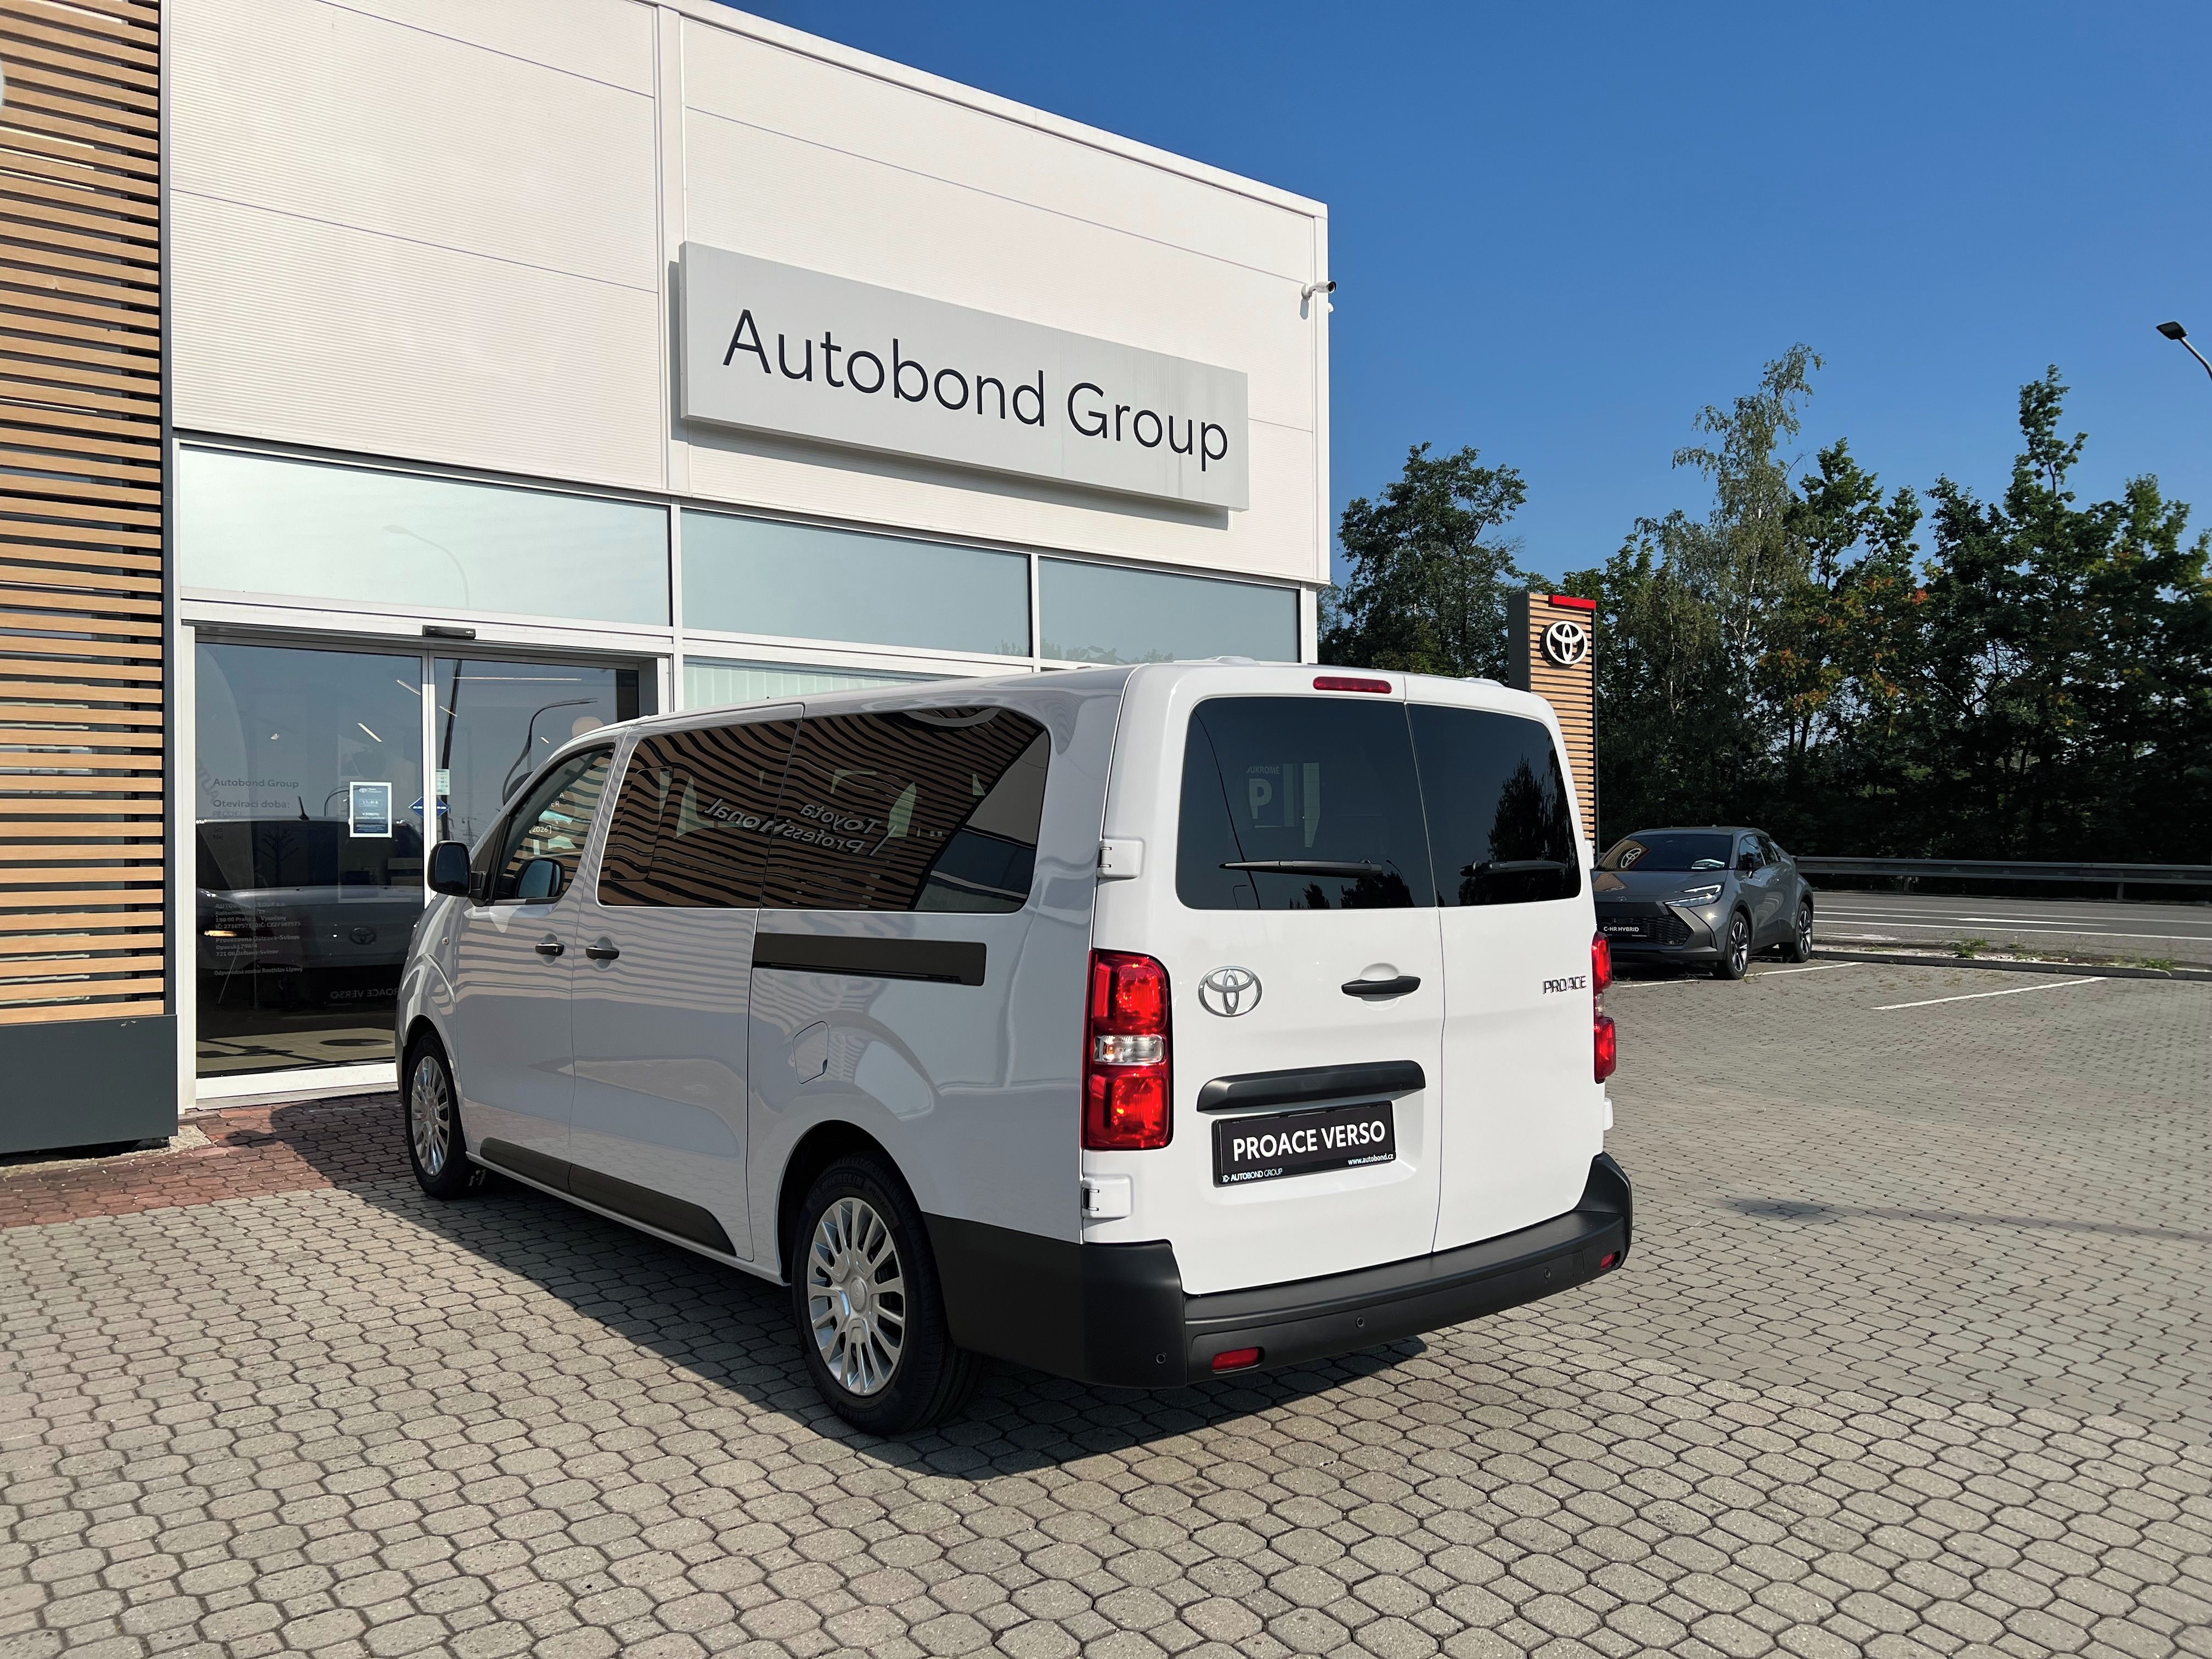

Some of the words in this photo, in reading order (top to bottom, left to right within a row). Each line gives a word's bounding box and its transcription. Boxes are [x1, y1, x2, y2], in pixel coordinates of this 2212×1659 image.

[723, 309, 1045, 427] Autobond
[1068, 382, 1228, 471] Group
[212, 778, 266, 788] Autobond
[268, 780, 299, 789] Group
[261, 800, 290, 808] doba:
[1249, 778, 1272, 820] P
[1542, 975, 1587, 994] PROACE
[1233, 1129, 1317, 1161] PROACE
[1321, 1121, 1385, 1149] VERSO
[1348, 1153, 1393, 1165] www.autobond.cz
[1231, 1170, 1263, 1182] AUTOBOND
[1264, 1167, 1283, 1178] GROUP
